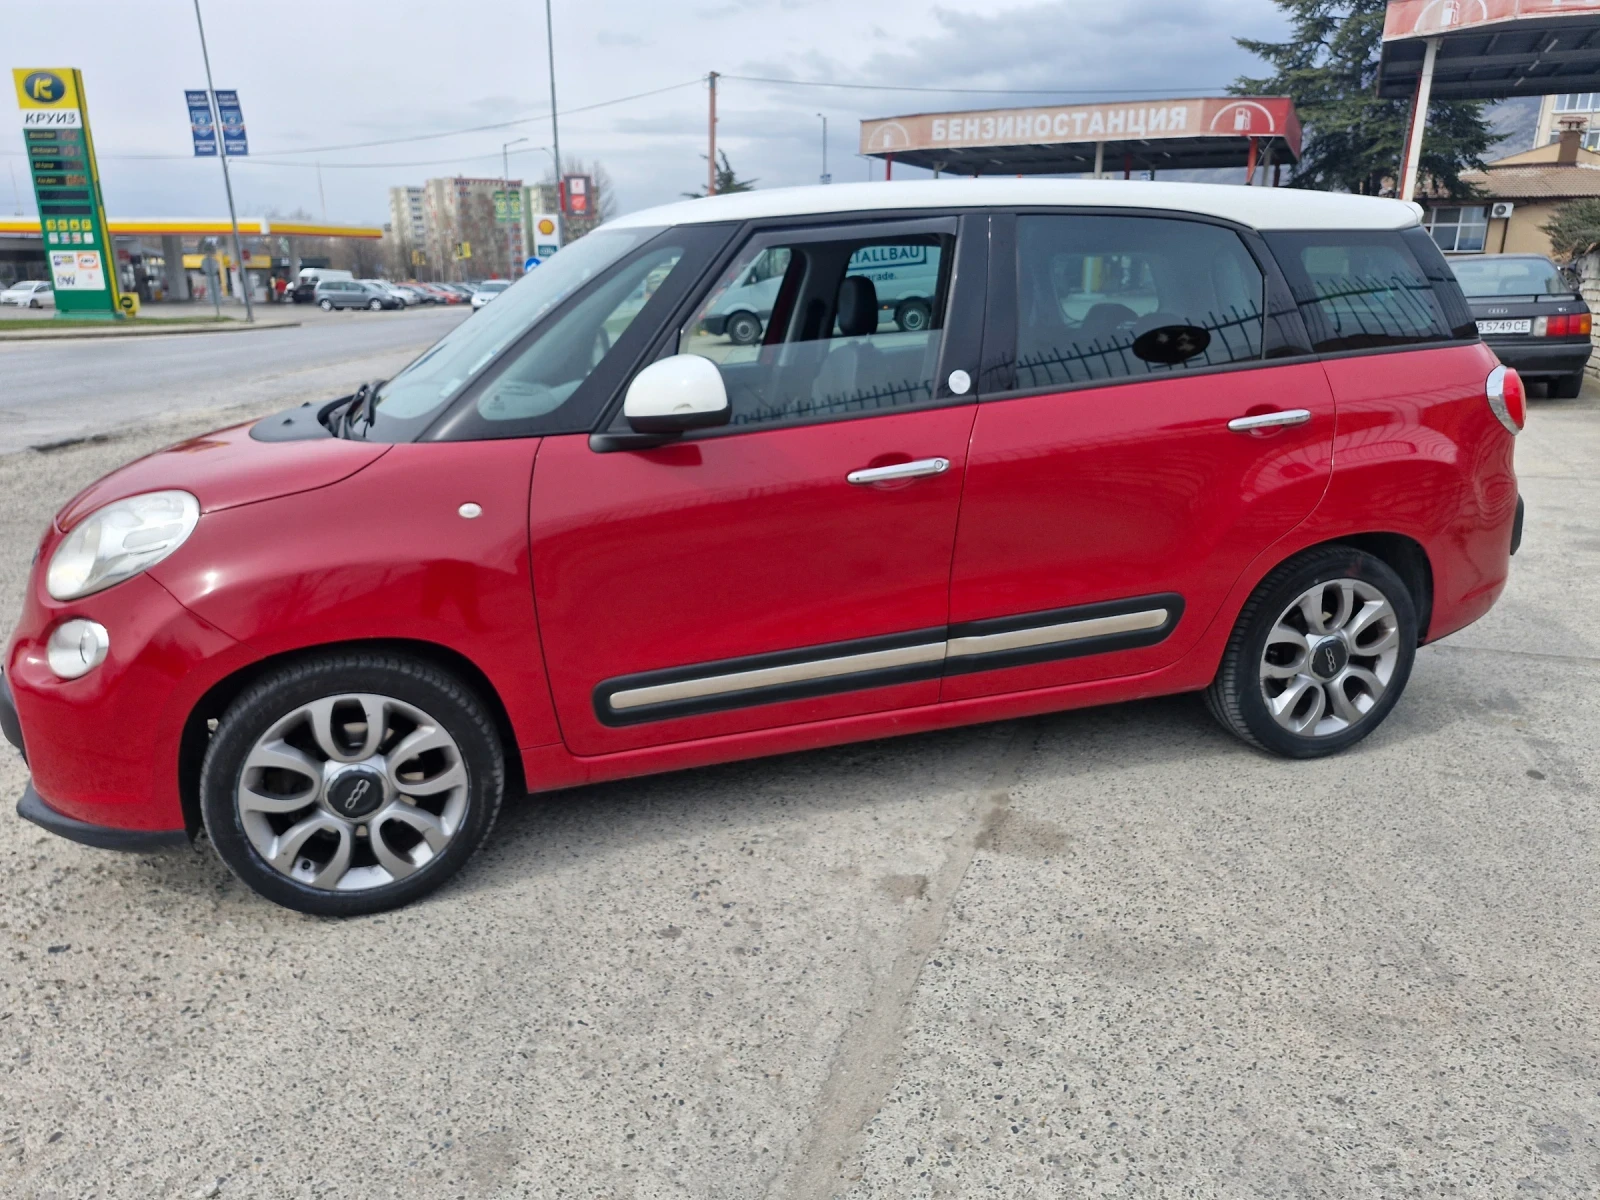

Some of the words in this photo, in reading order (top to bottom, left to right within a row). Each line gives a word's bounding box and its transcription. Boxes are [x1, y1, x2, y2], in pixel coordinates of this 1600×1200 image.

[25, 112, 76, 124] КРУИЗ
[931, 106, 1187, 141] БЕНЗИНОСТАНЦИЯ
[848, 246, 919, 265] TALLBAU
[1486, 321, 1512, 331] 5749
